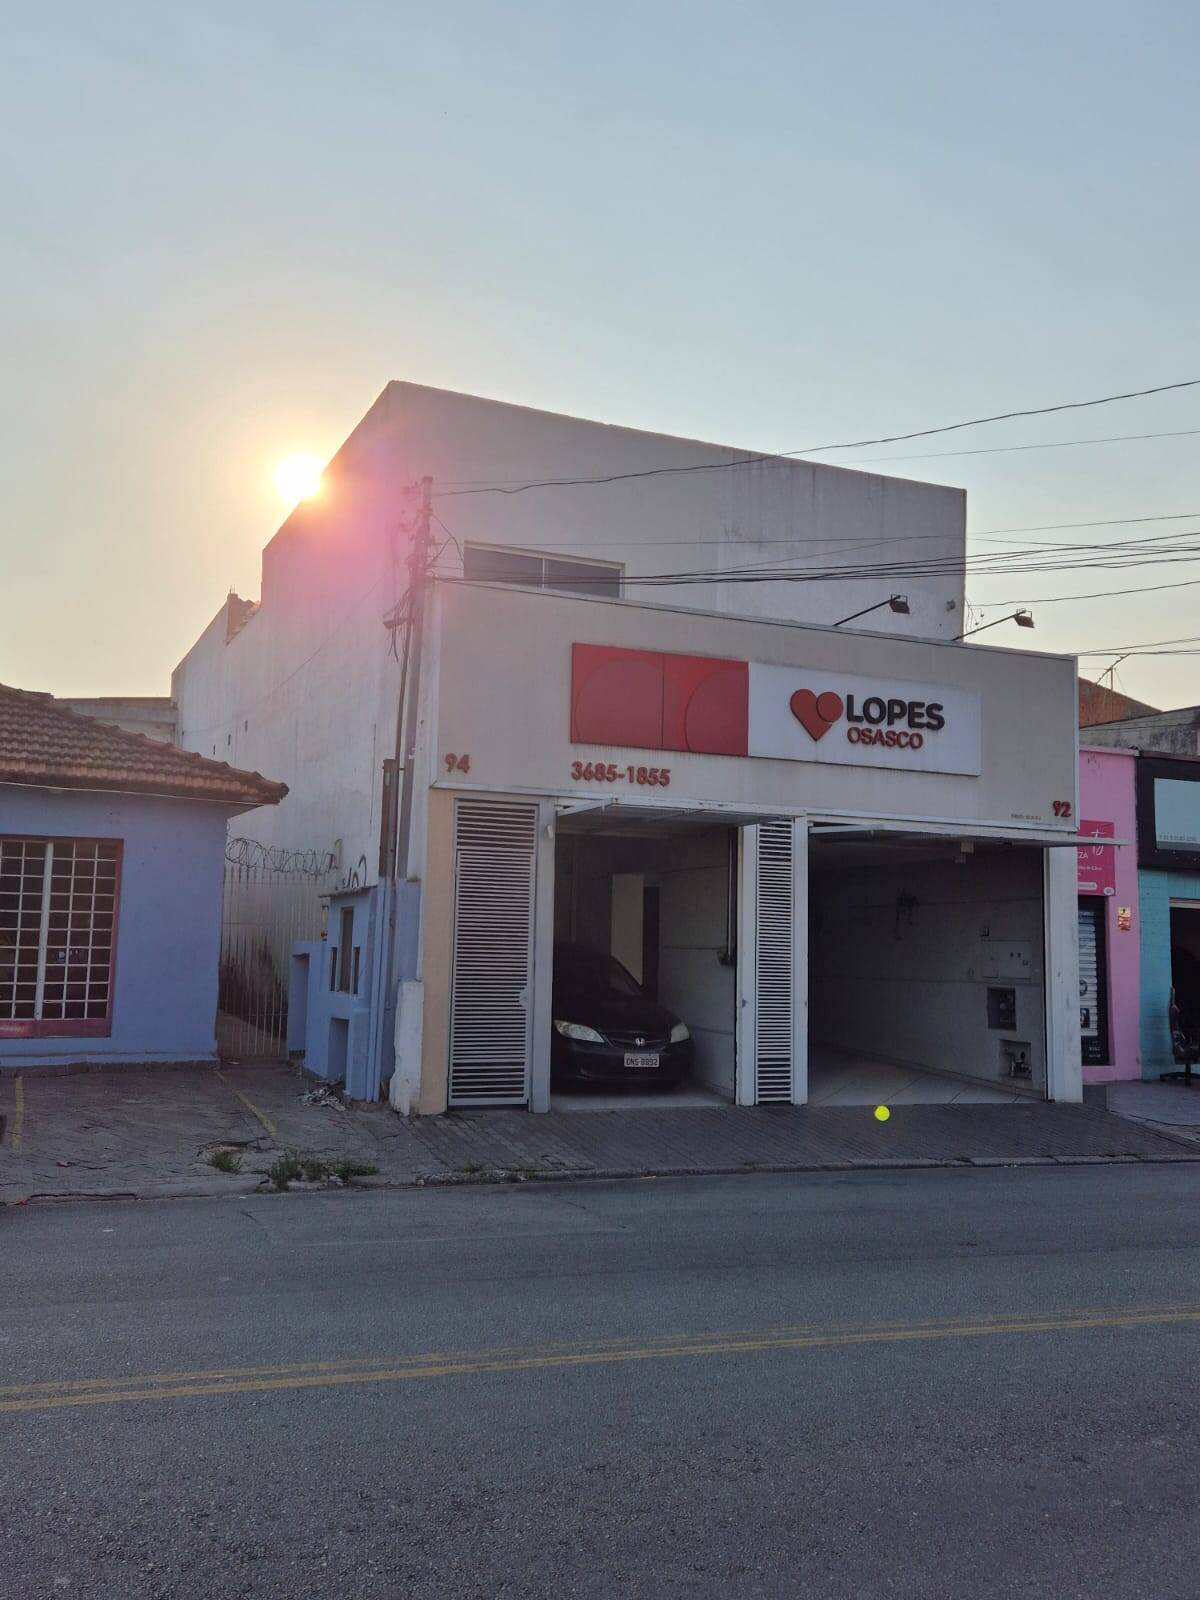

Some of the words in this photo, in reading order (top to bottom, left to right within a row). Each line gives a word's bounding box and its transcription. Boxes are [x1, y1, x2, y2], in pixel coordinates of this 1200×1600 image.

[846, 694, 945, 731] LOPES
[847, 726, 923, 749] OSASCO
[445, 753, 470, 774] 94
[571, 761, 671, 787] 3685-1855
[1052, 800, 1072, 818] 92
